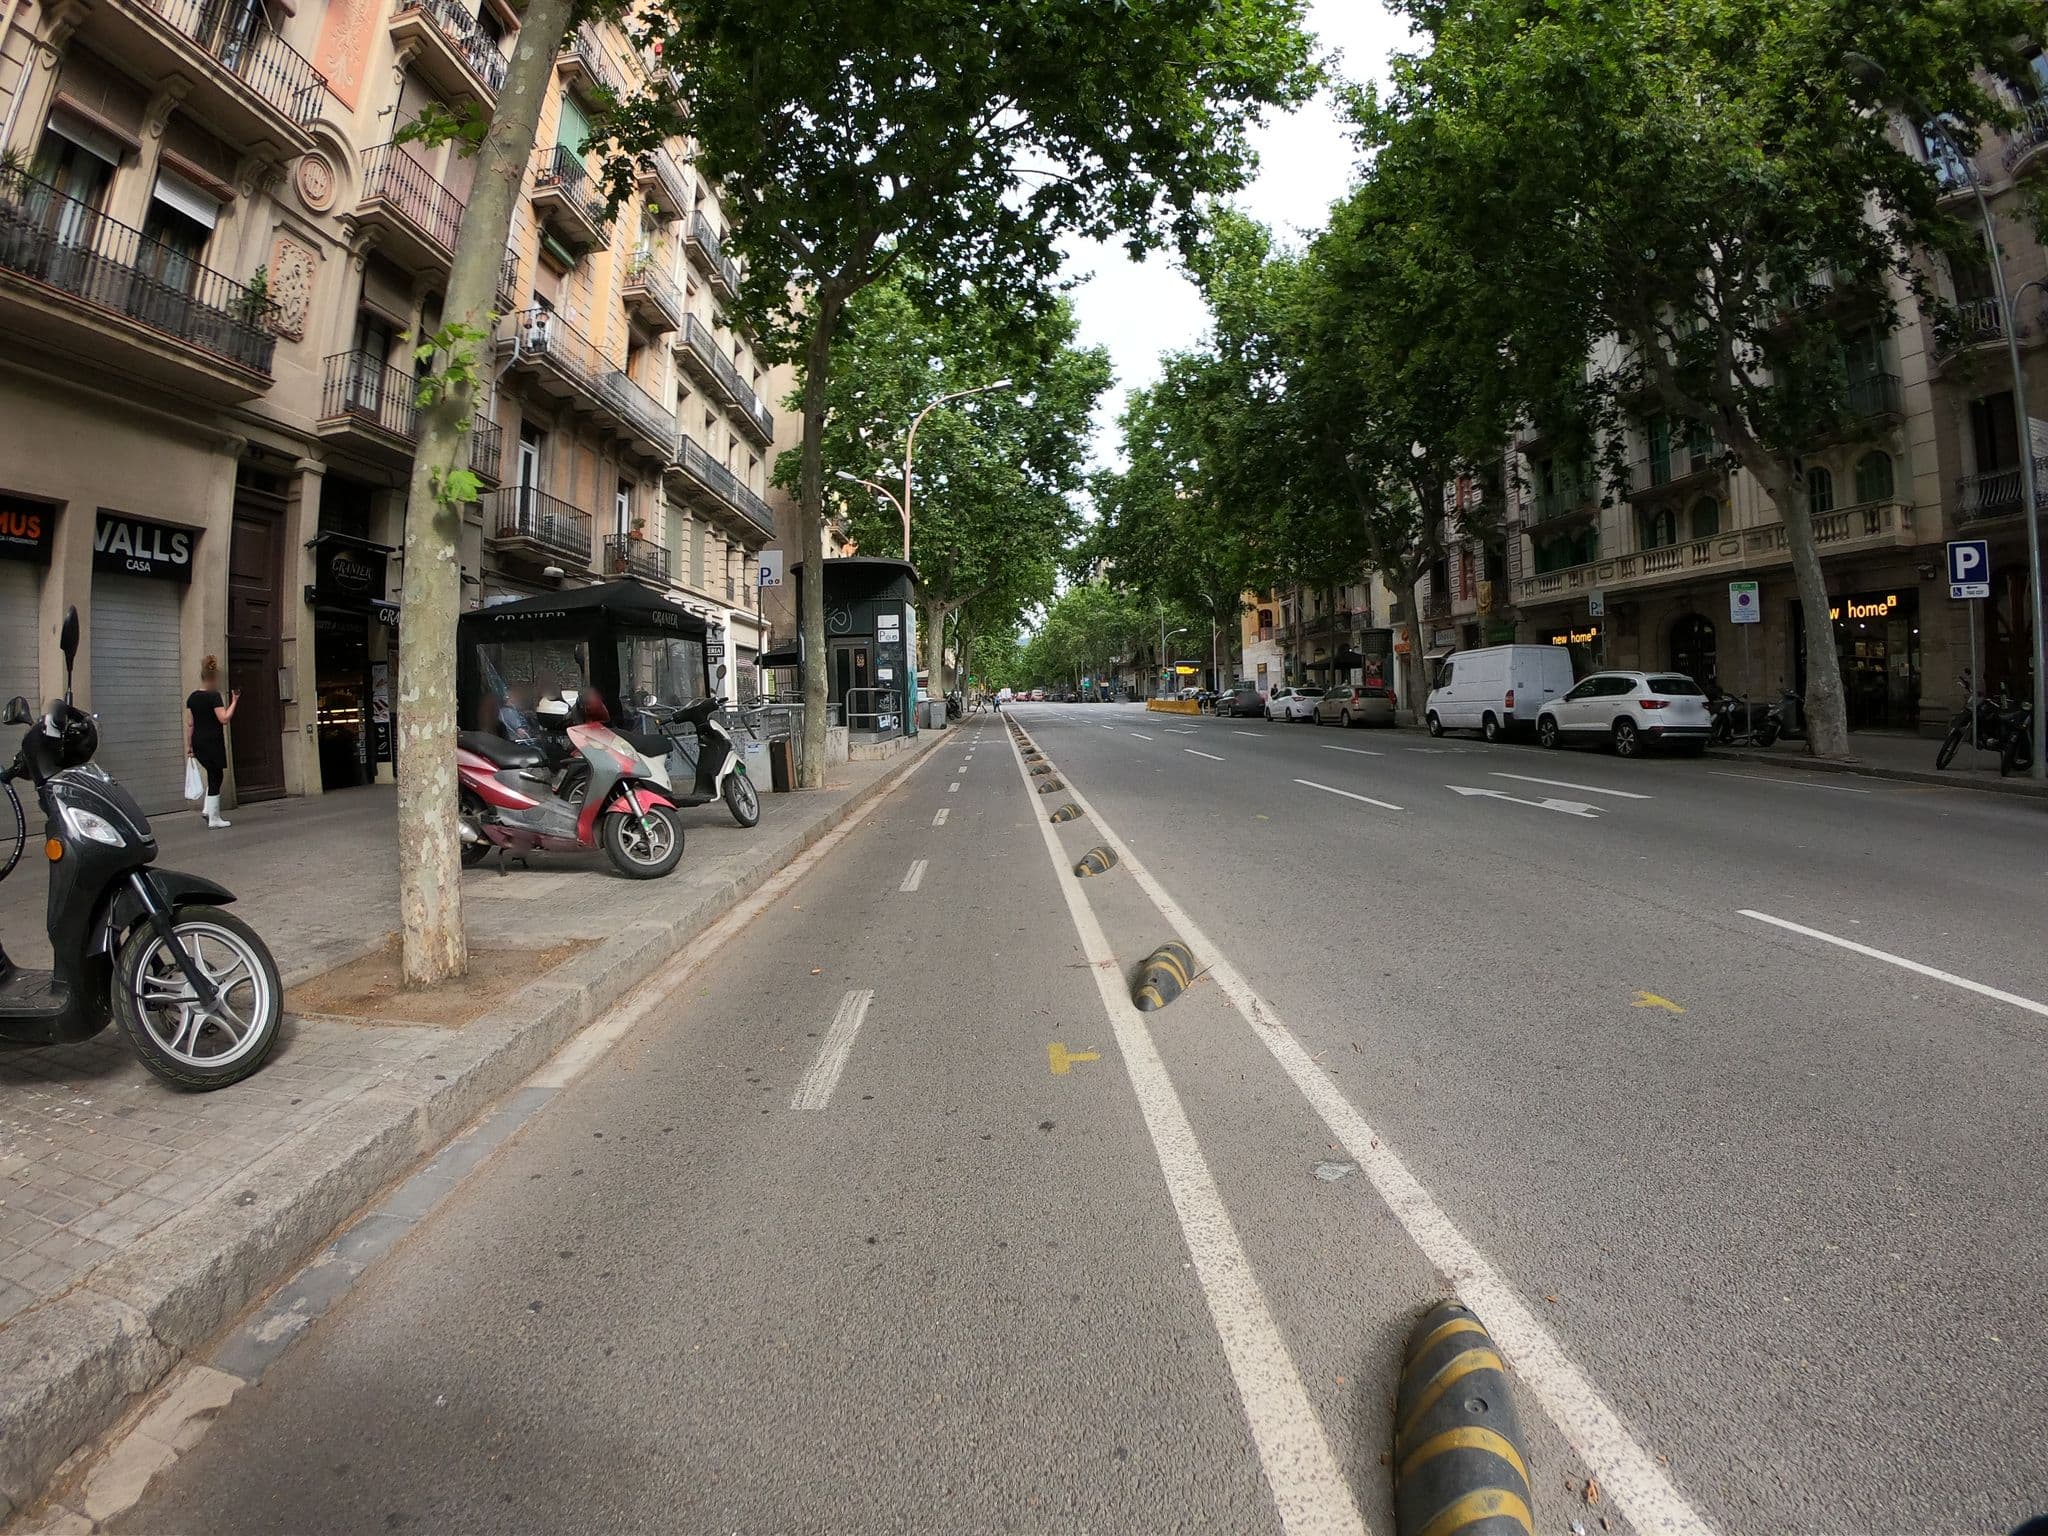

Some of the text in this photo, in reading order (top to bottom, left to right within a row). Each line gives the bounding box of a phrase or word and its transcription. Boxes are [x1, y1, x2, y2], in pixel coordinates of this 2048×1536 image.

[93, 520, 189, 564] VALLS
[126, 558, 151, 573] CASA
[1955, 546, 1980, 580] P
[1847, 599, 1888, 618] home
[1552, 630, 1592, 645] new home
